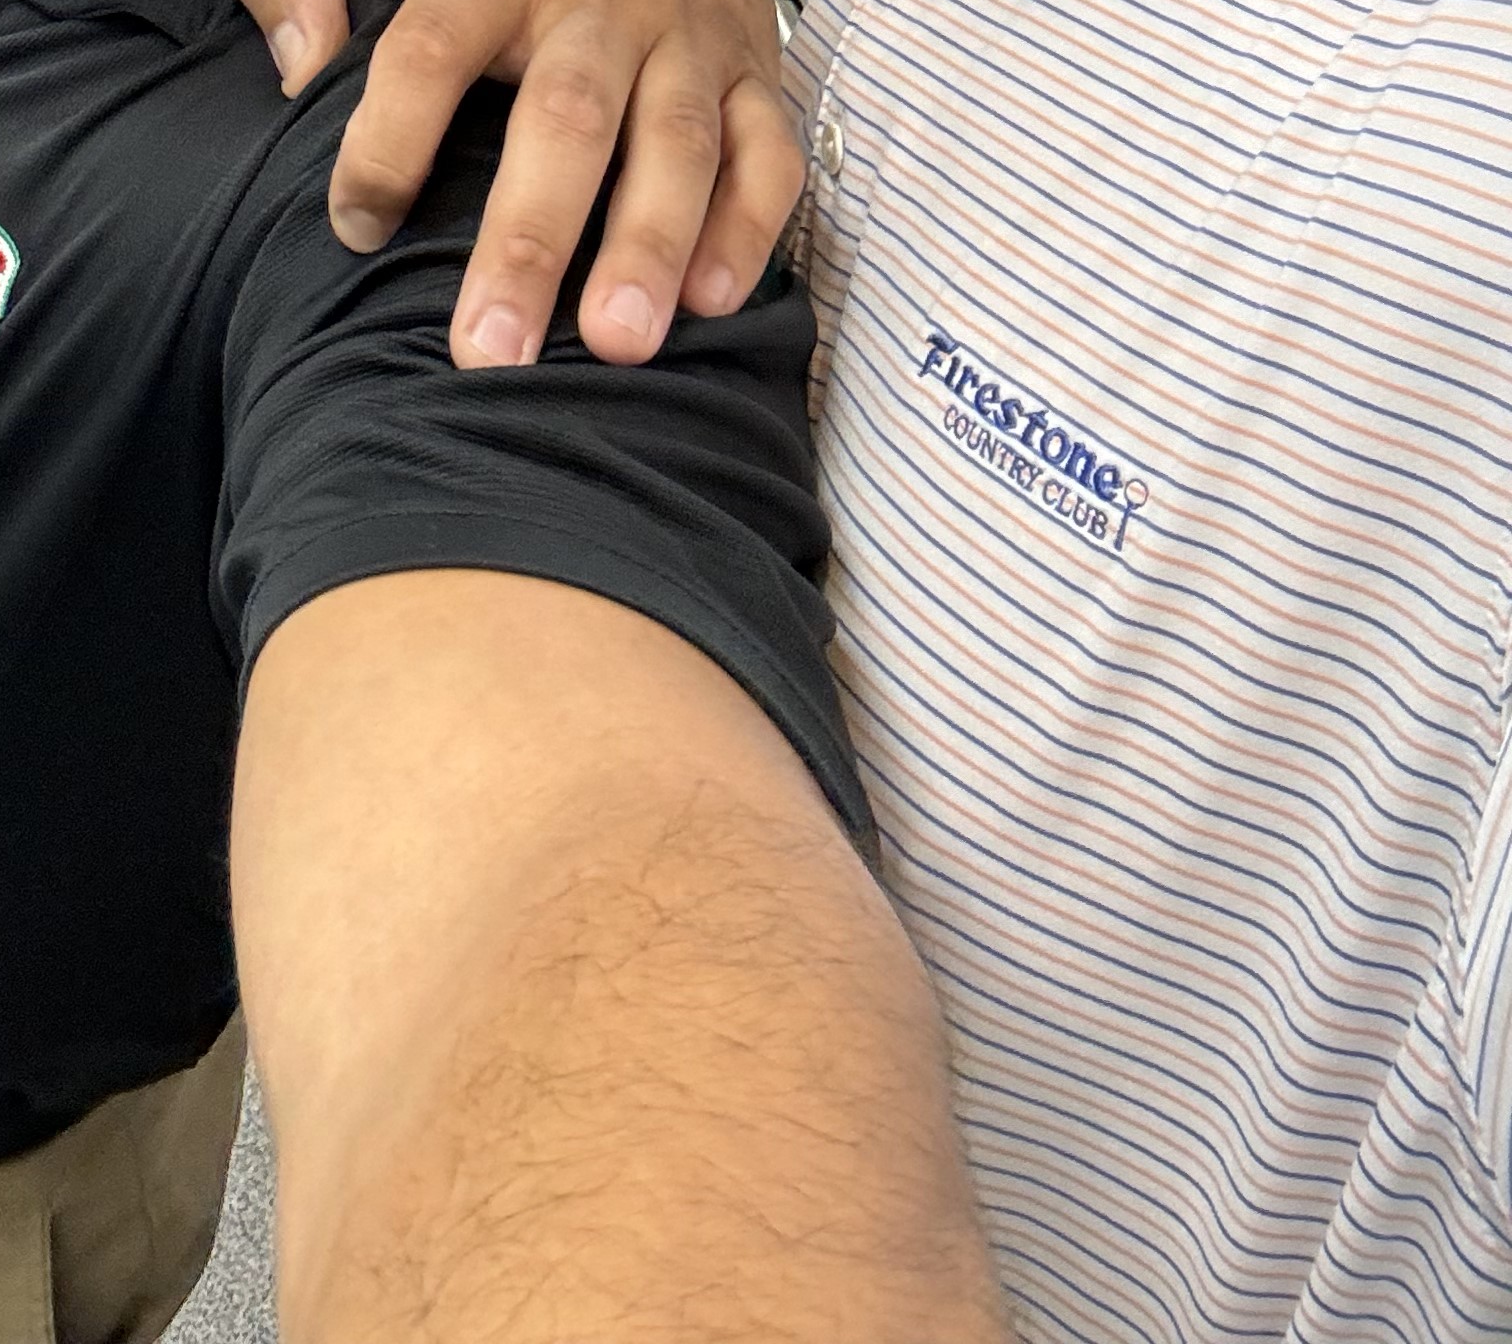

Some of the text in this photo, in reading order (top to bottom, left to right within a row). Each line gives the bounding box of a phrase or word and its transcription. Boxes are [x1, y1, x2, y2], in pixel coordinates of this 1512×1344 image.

[917, 330, 1125, 504] Firestone
[943, 404, 1110, 541] COUNTRY CLUB
